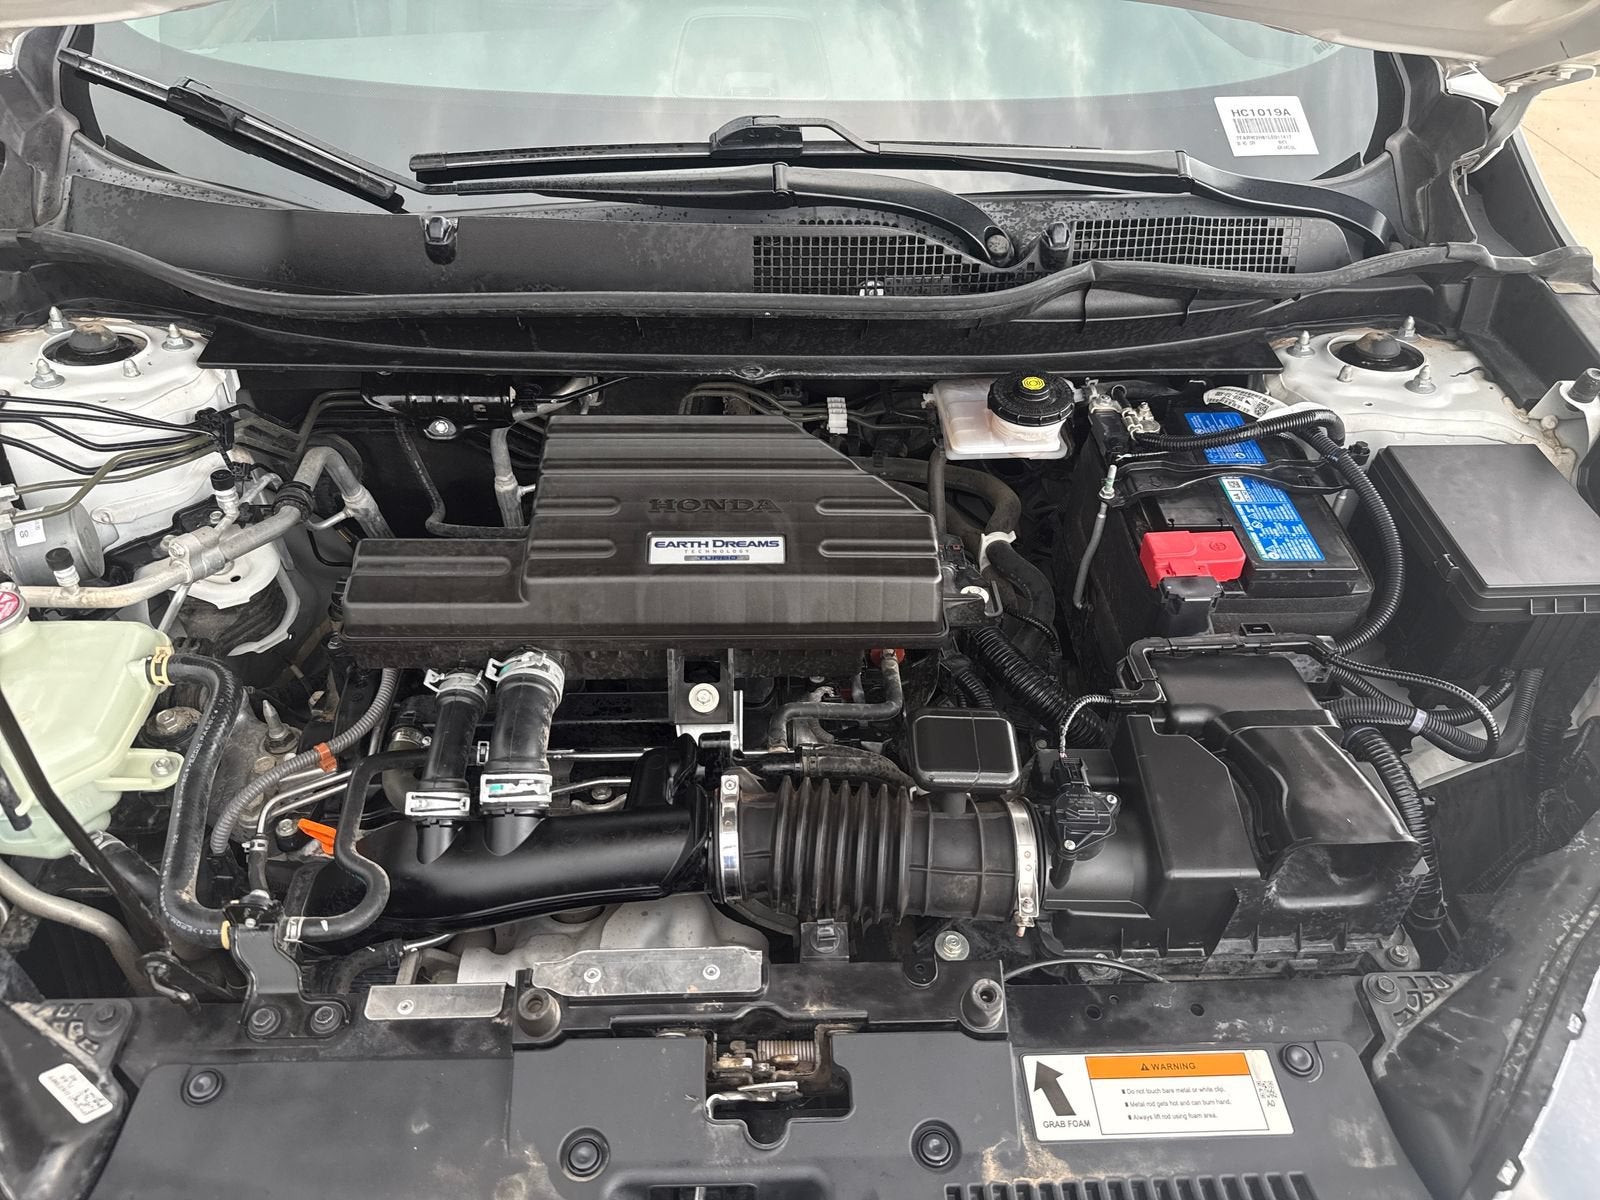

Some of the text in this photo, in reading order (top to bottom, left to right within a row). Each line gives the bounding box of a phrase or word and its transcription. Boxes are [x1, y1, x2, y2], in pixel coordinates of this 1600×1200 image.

[1231, 108, 1291, 117] HC1019A
[647, 499, 783, 513] HONDA
[712, 539, 780, 548] DREAMS
[1150, 1062, 1196, 1070] WARNING
[1042, 1119, 1091, 1128] GRAB FOAM
